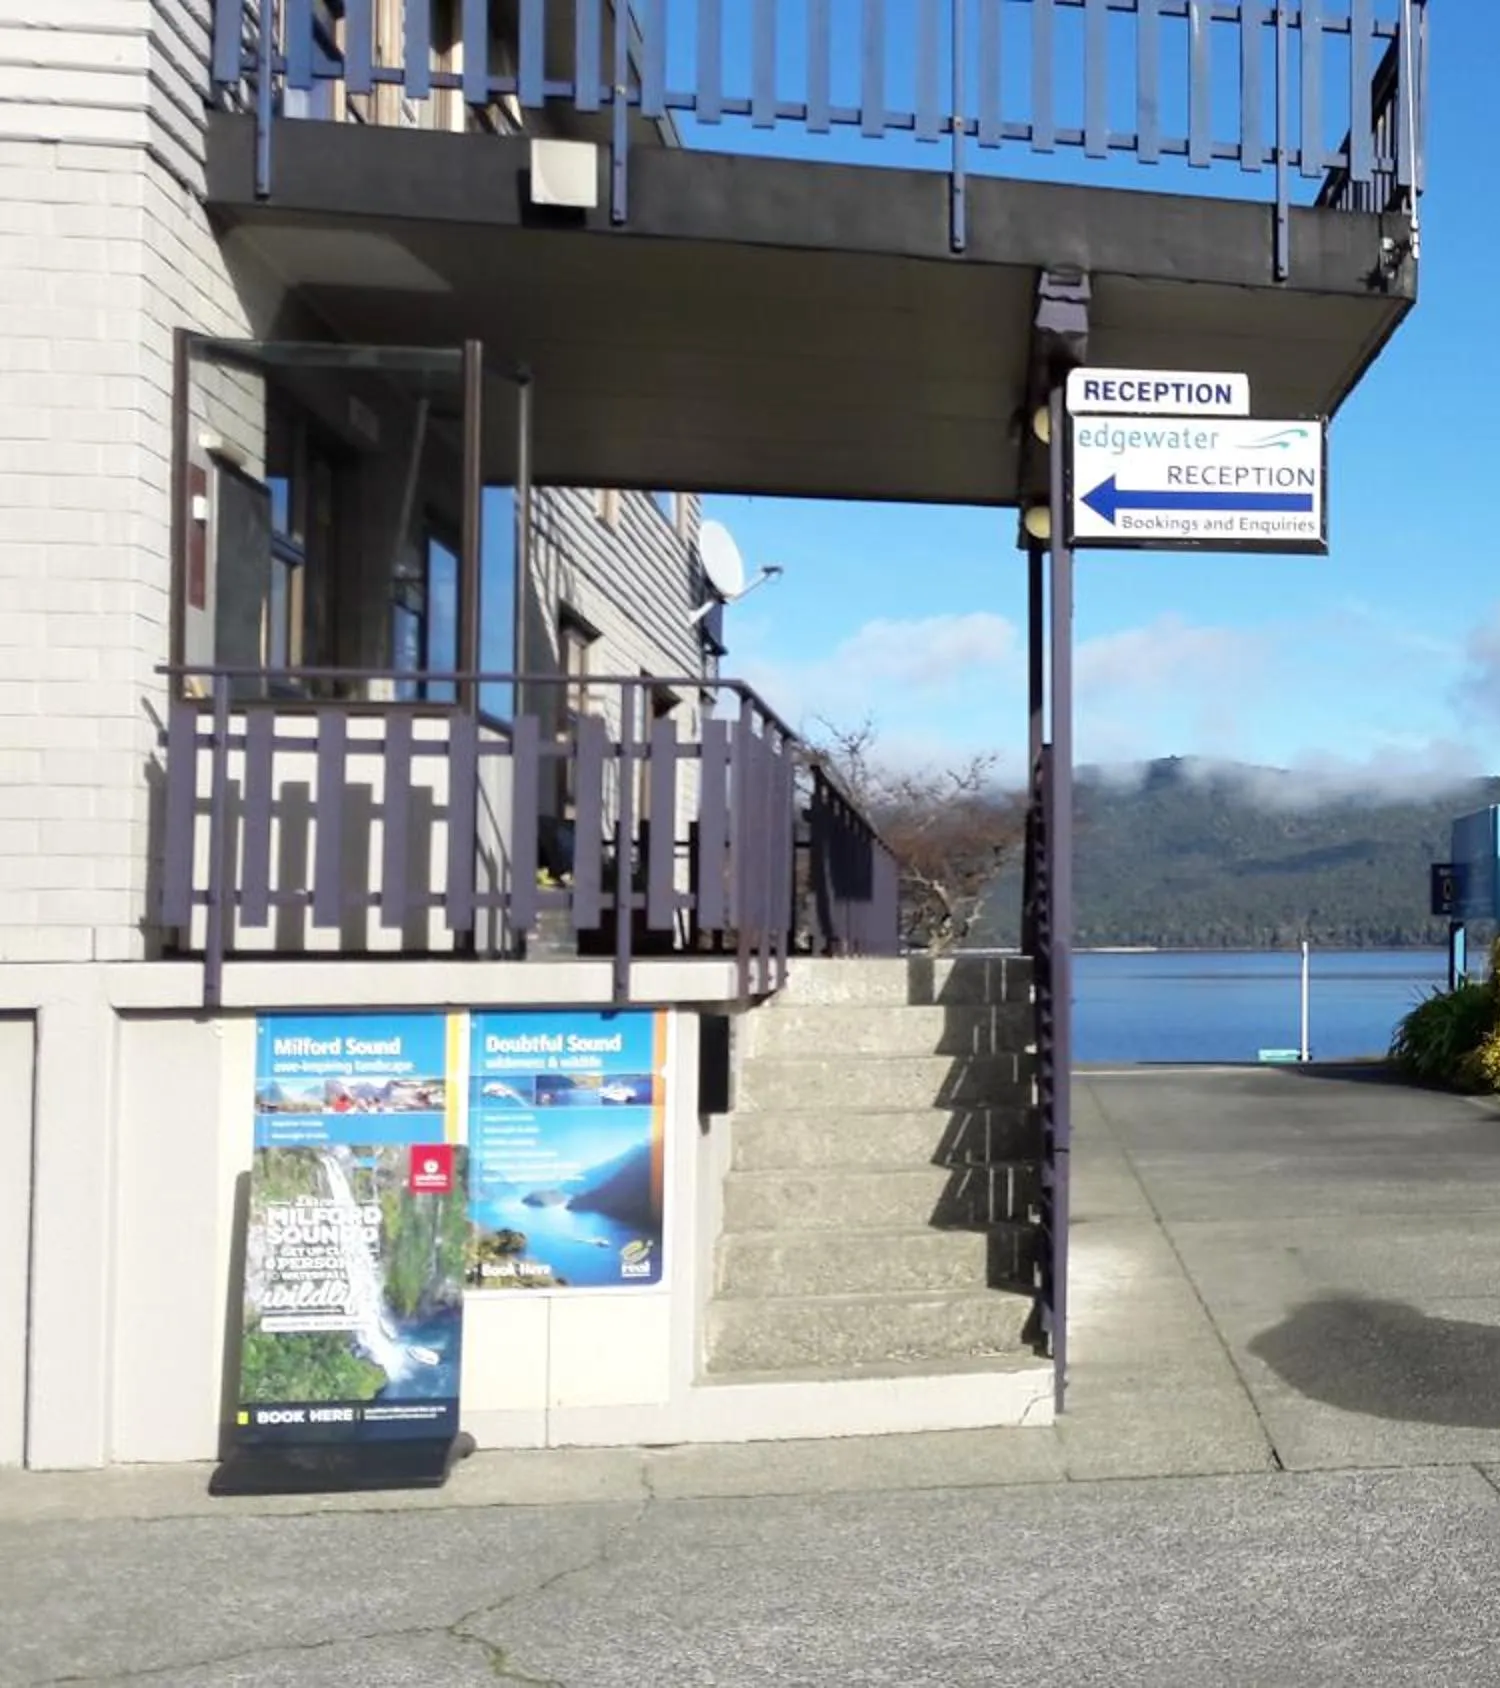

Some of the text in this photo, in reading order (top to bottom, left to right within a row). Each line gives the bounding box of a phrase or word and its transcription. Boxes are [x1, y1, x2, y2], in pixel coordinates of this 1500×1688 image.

[1084, 380, 1232, 404] RECEPTION
[1078, 422, 1219, 455] edgewater
[1167, 465, 1315, 486] RECEPTION
[1121, 515, 1316, 534] Bookings and Enquiries
[274, 1037, 401, 1056] Milford Sound
[486, 1034, 622, 1053] Doubtful Sound
[267, 1206, 382, 1226] MILFORD
[256, 1409, 304, 1425] BOOK
[310, 1408, 353, 1422] HERE
